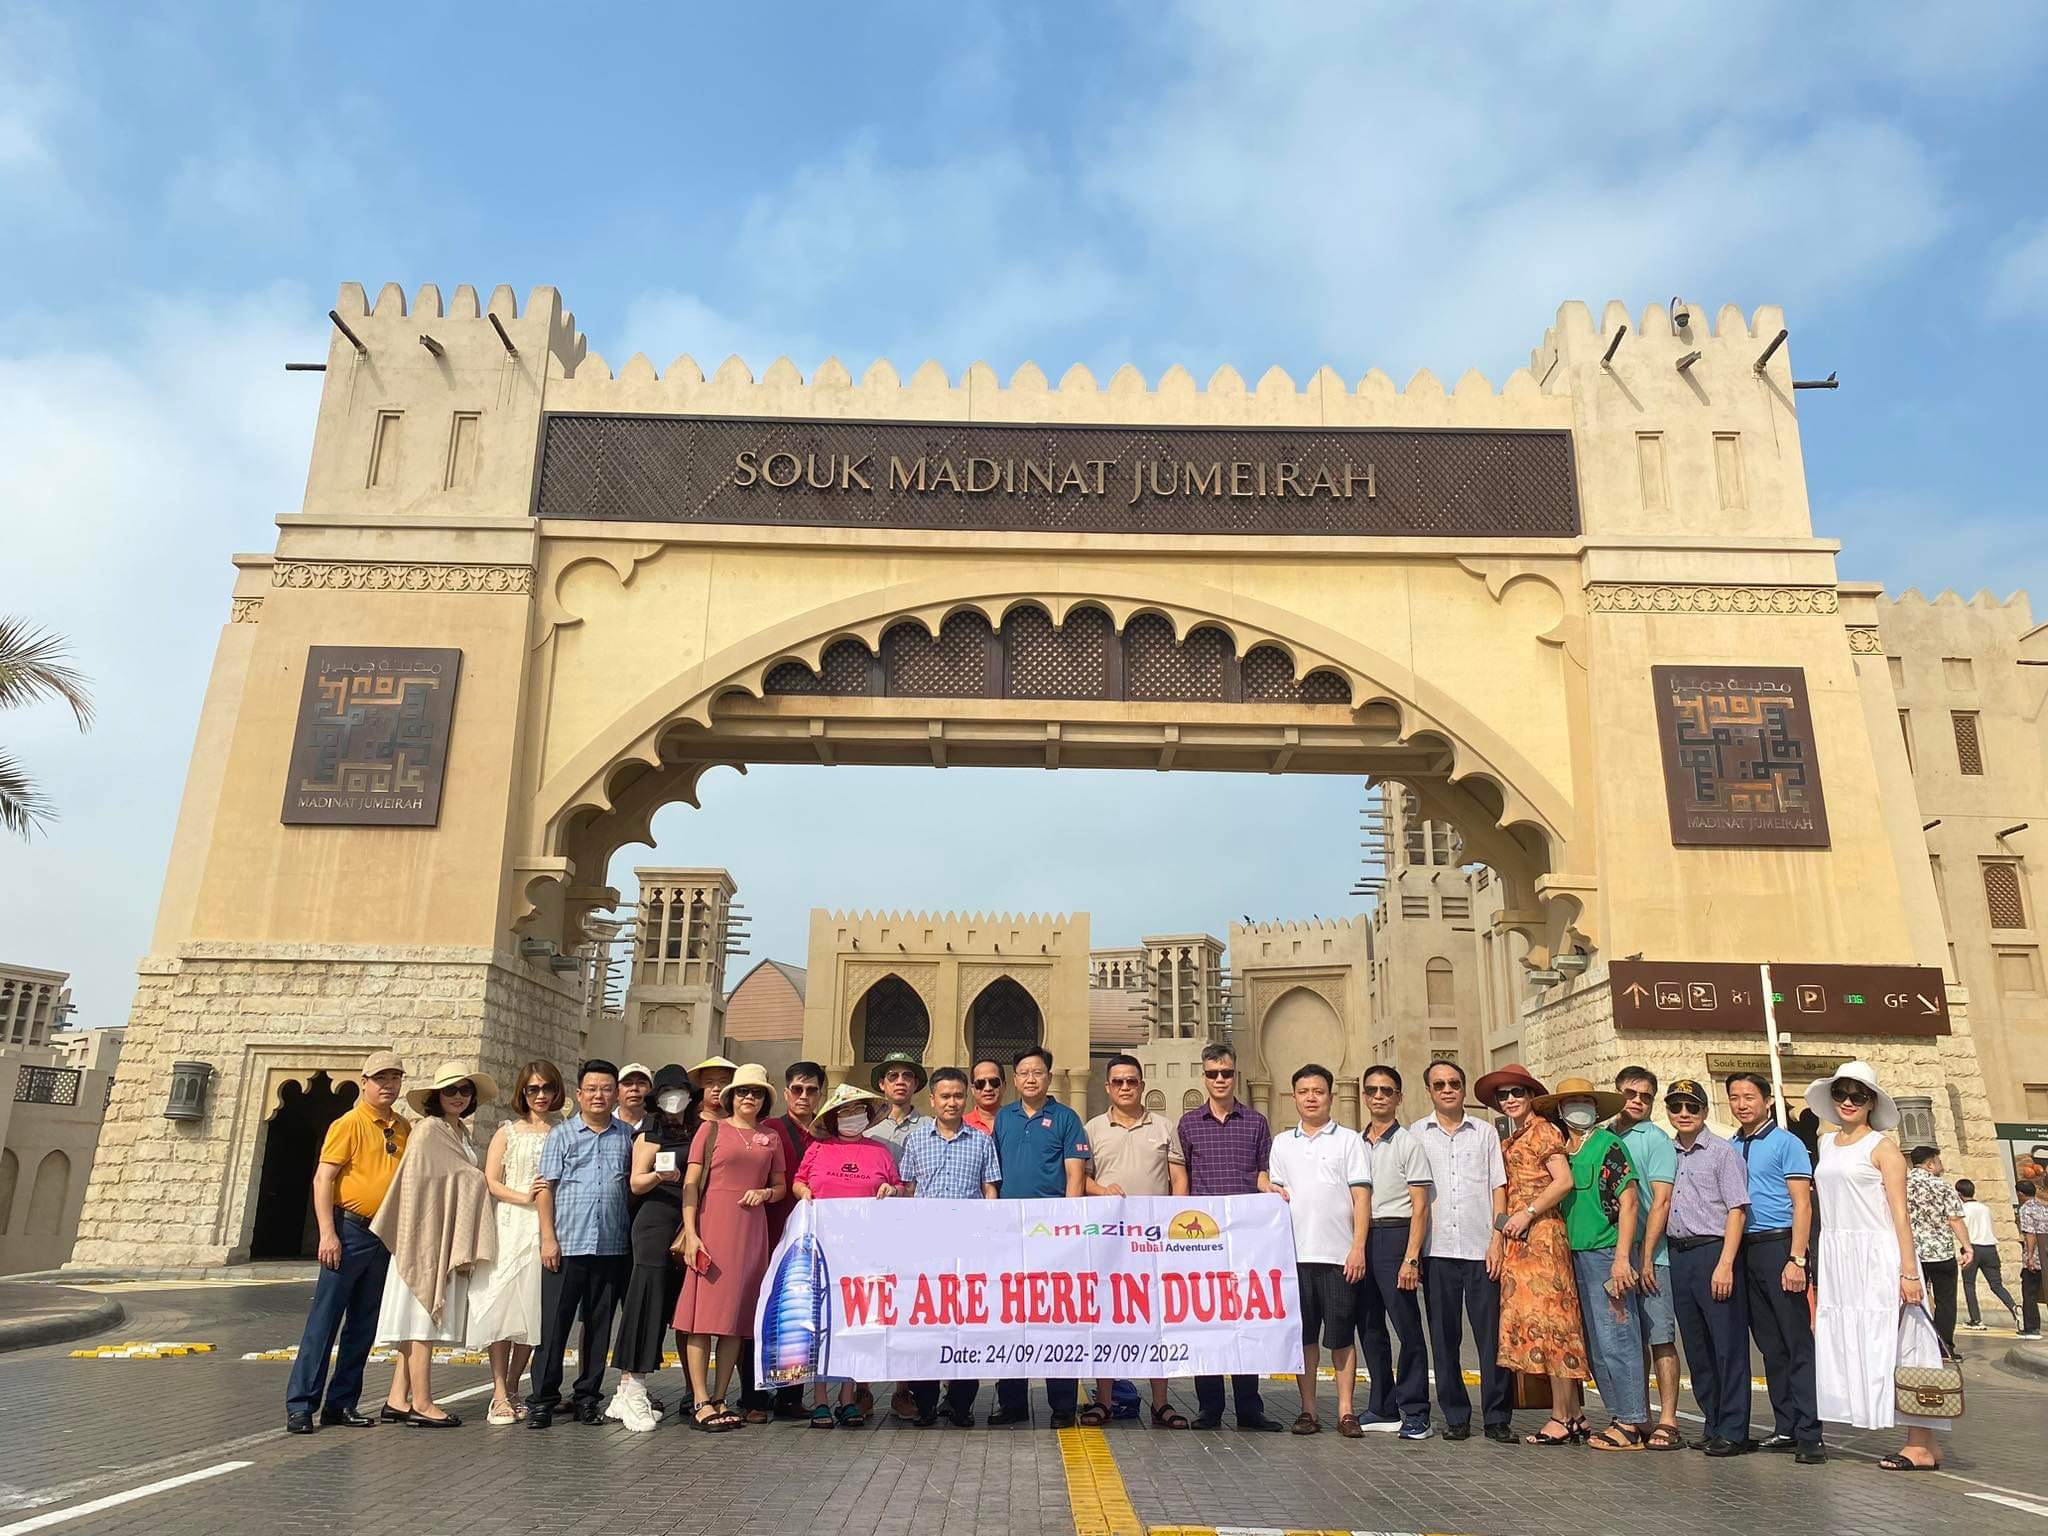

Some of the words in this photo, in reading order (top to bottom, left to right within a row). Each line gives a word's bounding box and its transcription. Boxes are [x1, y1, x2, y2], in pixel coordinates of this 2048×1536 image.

[734, 450, 874, 490] SOUK
[889, 455, 1115, 494] MADINAT
[1129, 459, 1377, 504] JUMEIRAH
[297, 796, 358, 809] MADINAT
[358, 797, 424, 811] JUMEIRAH
[1687, 815, 1746, 829] MADINAT
[1748, 816, 1814, 832] JUMEIRAH
[1884, 992, 1909, 1009] GF
[1713, 1059, 1735, 1069] Souk
[1737, 1060, 1772, 1070] Entranc
[1029, 1220, 1161, 1242] Amazing
[1130, 1240, 1164, 1253] Dubai
[1165, 1241, 1224, 1253] Adventures
[839, 1273, 899, 1328] WE
[909, 1271, 989, 1326] ARE
[999, 1271, 1101, 1326] HERE
[1110, 1270, 1154, 1325] IN
[1161, 1268, 1288, 1325] DUBAI
[940, 1344, 982, 1365] Date:
[985, 1344, 1089, 1364] 24/09/2022-
[1093, 1342, 1190, 1363] 29/09/2022
